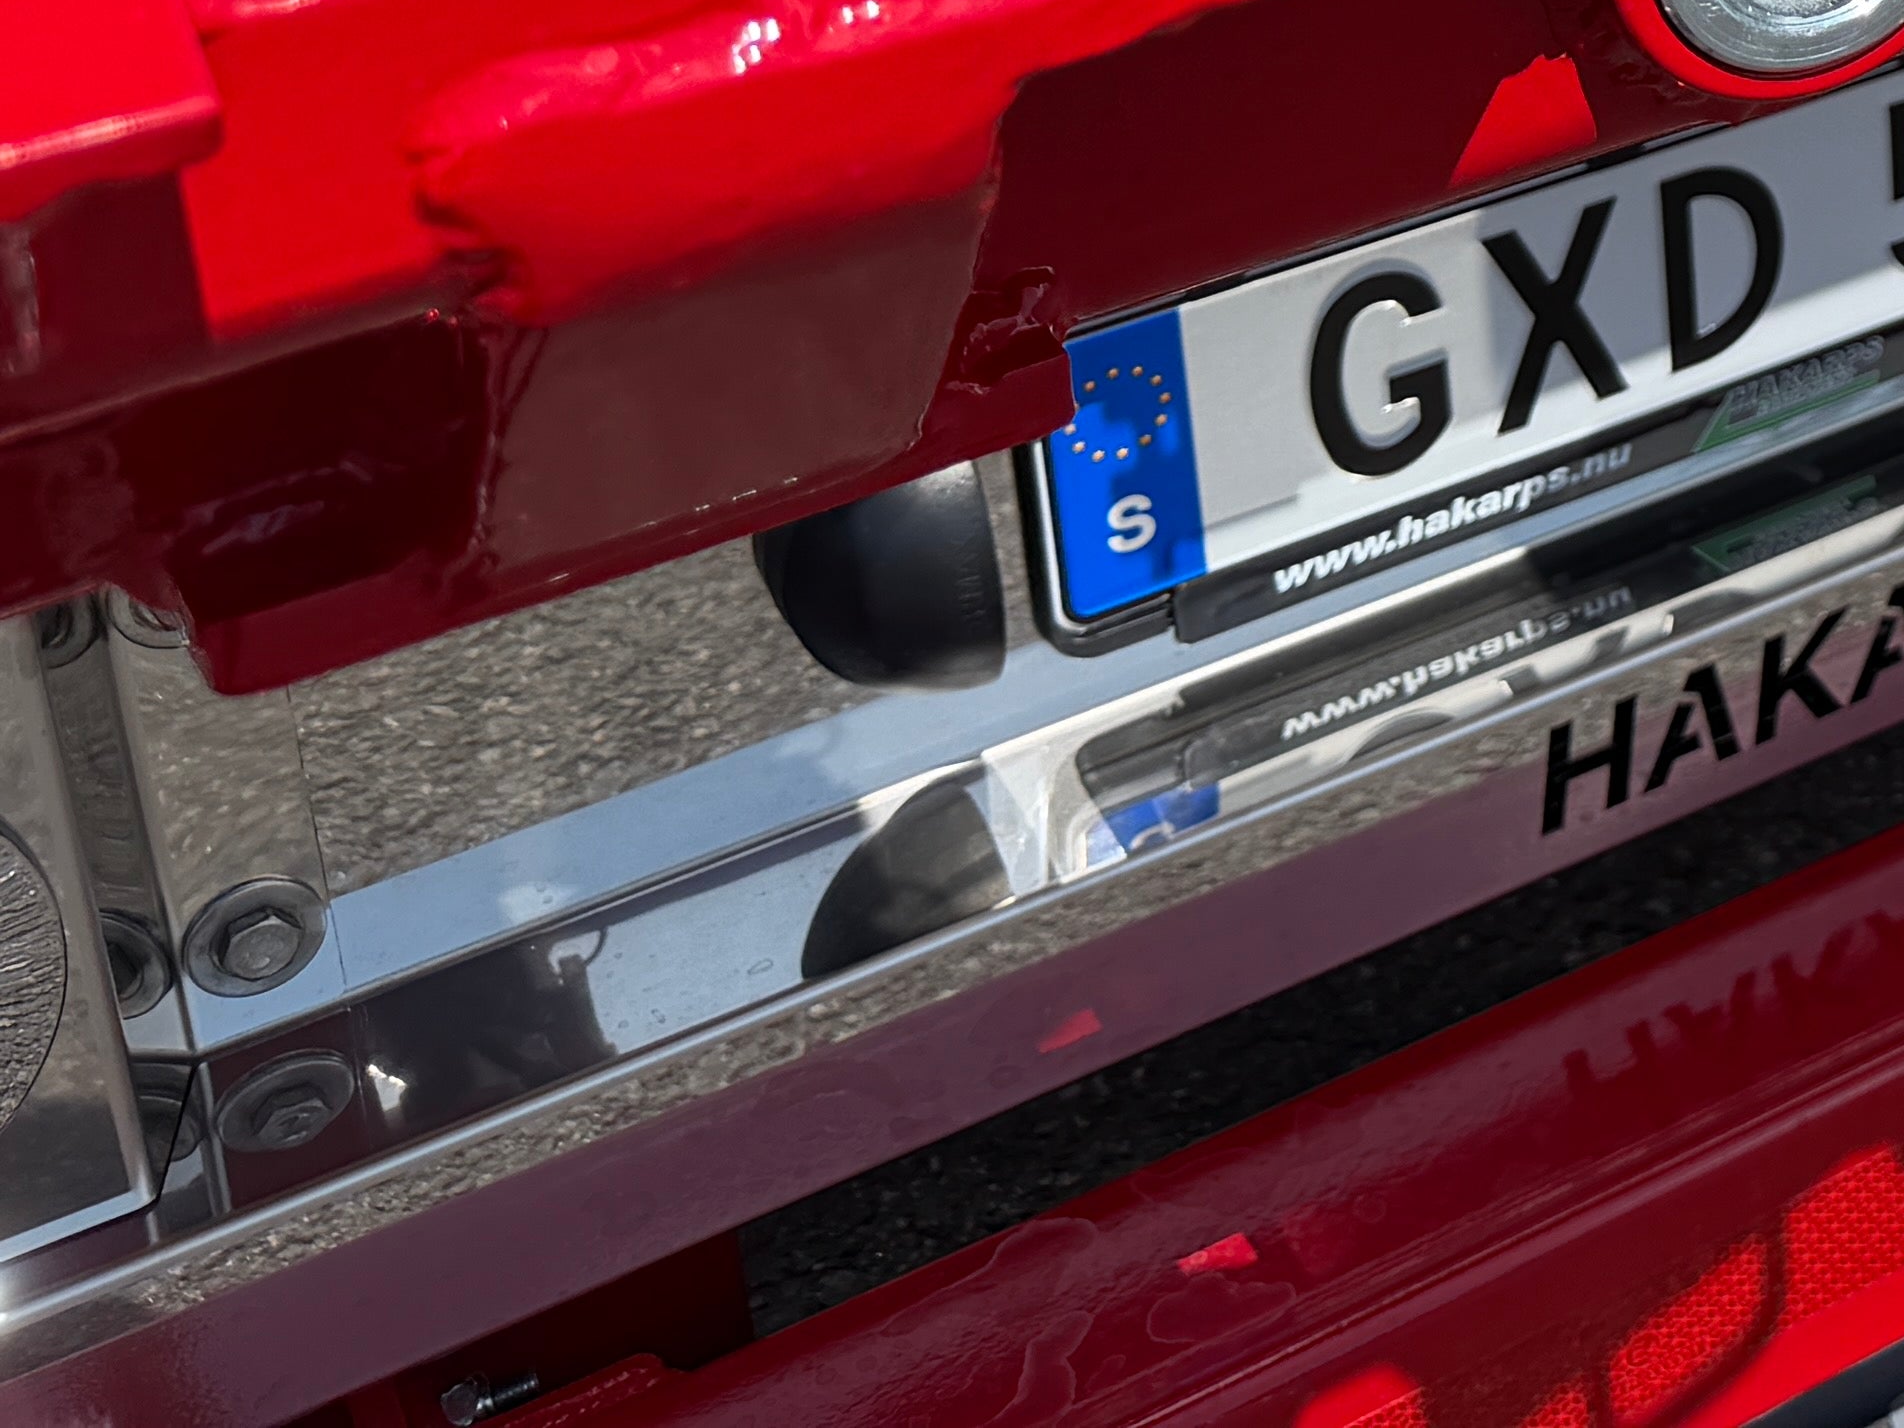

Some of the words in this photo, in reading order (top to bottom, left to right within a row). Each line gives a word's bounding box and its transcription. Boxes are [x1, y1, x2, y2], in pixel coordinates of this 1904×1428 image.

[1310, 165, 1784, 478] GXD
[1107, 494, 1158, 553] S
[1273, 444, 1632, 595] www.hakarps.nu
